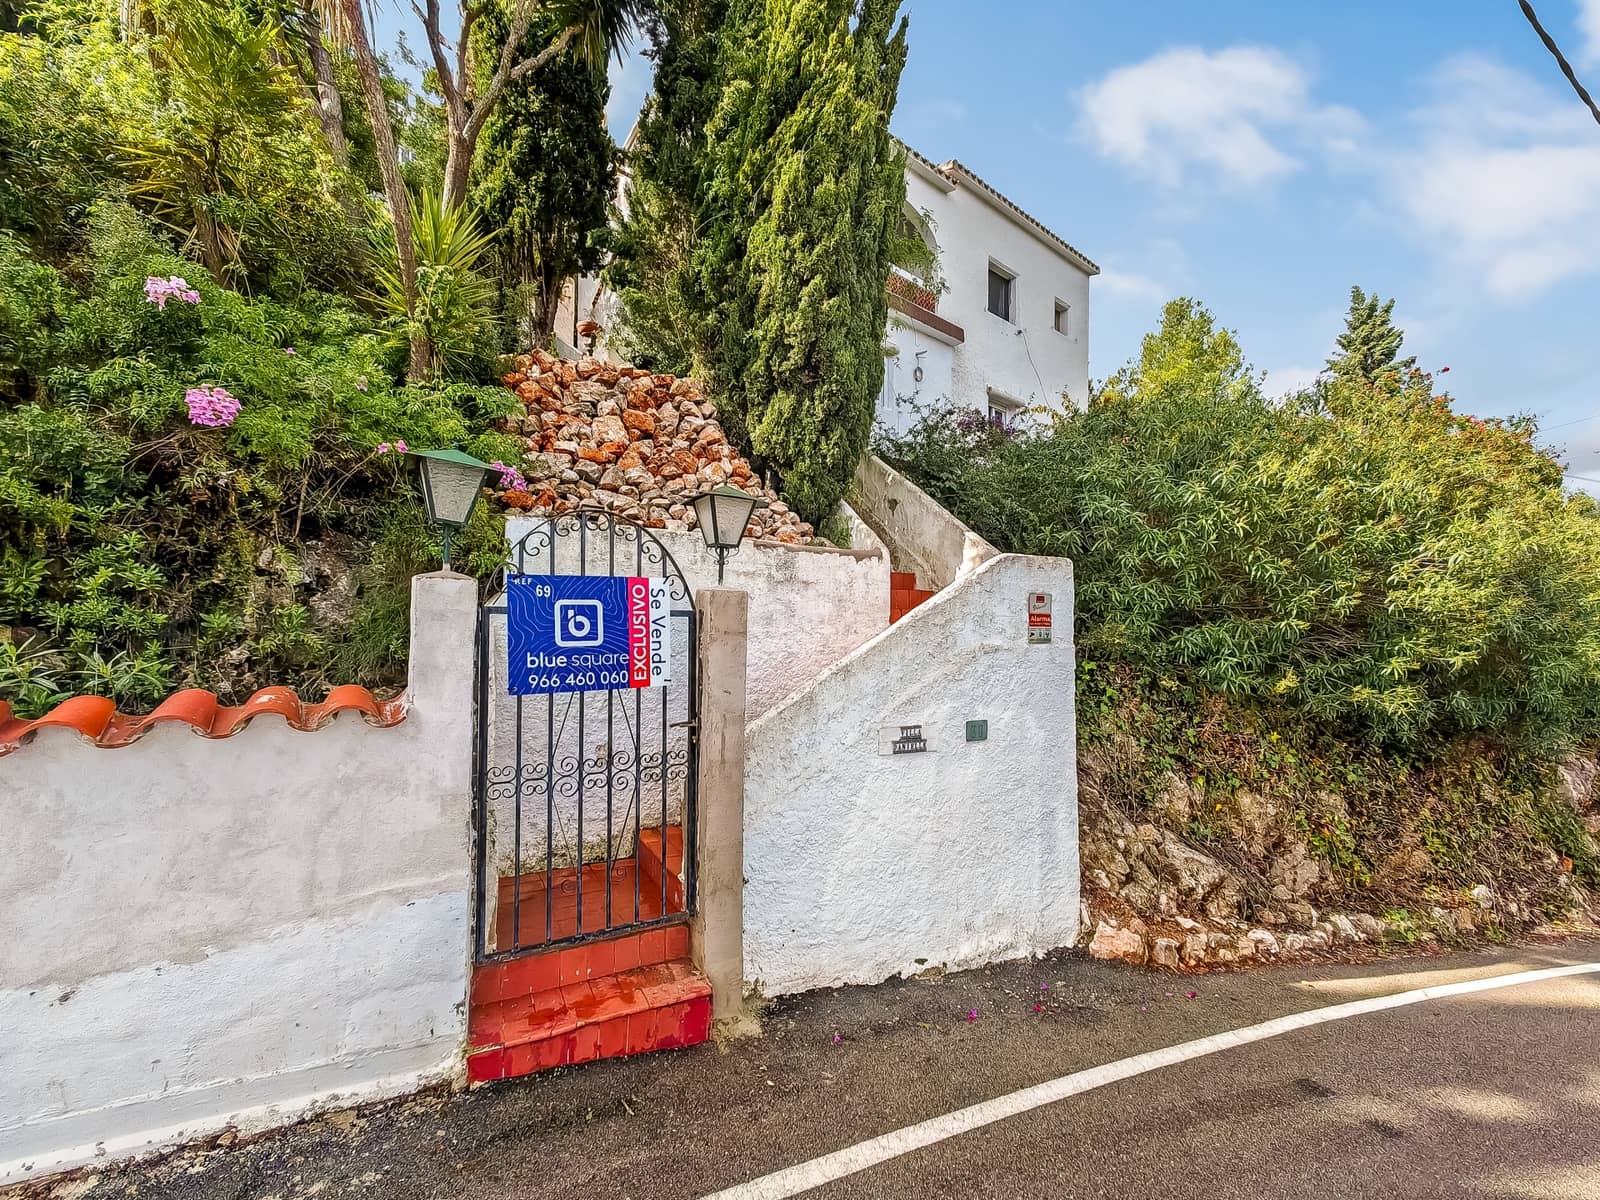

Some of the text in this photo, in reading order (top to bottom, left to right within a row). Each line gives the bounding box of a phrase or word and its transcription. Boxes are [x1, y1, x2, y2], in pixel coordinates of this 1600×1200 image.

[536, 584, 551, 598] 69
[632, 584, 647, 681] EXCLUSIVO
[650, 588, 666, 676] Se Vende
[527, 651, 630, 669] blue square
[528, 670, 629, 688] 966 460 060
